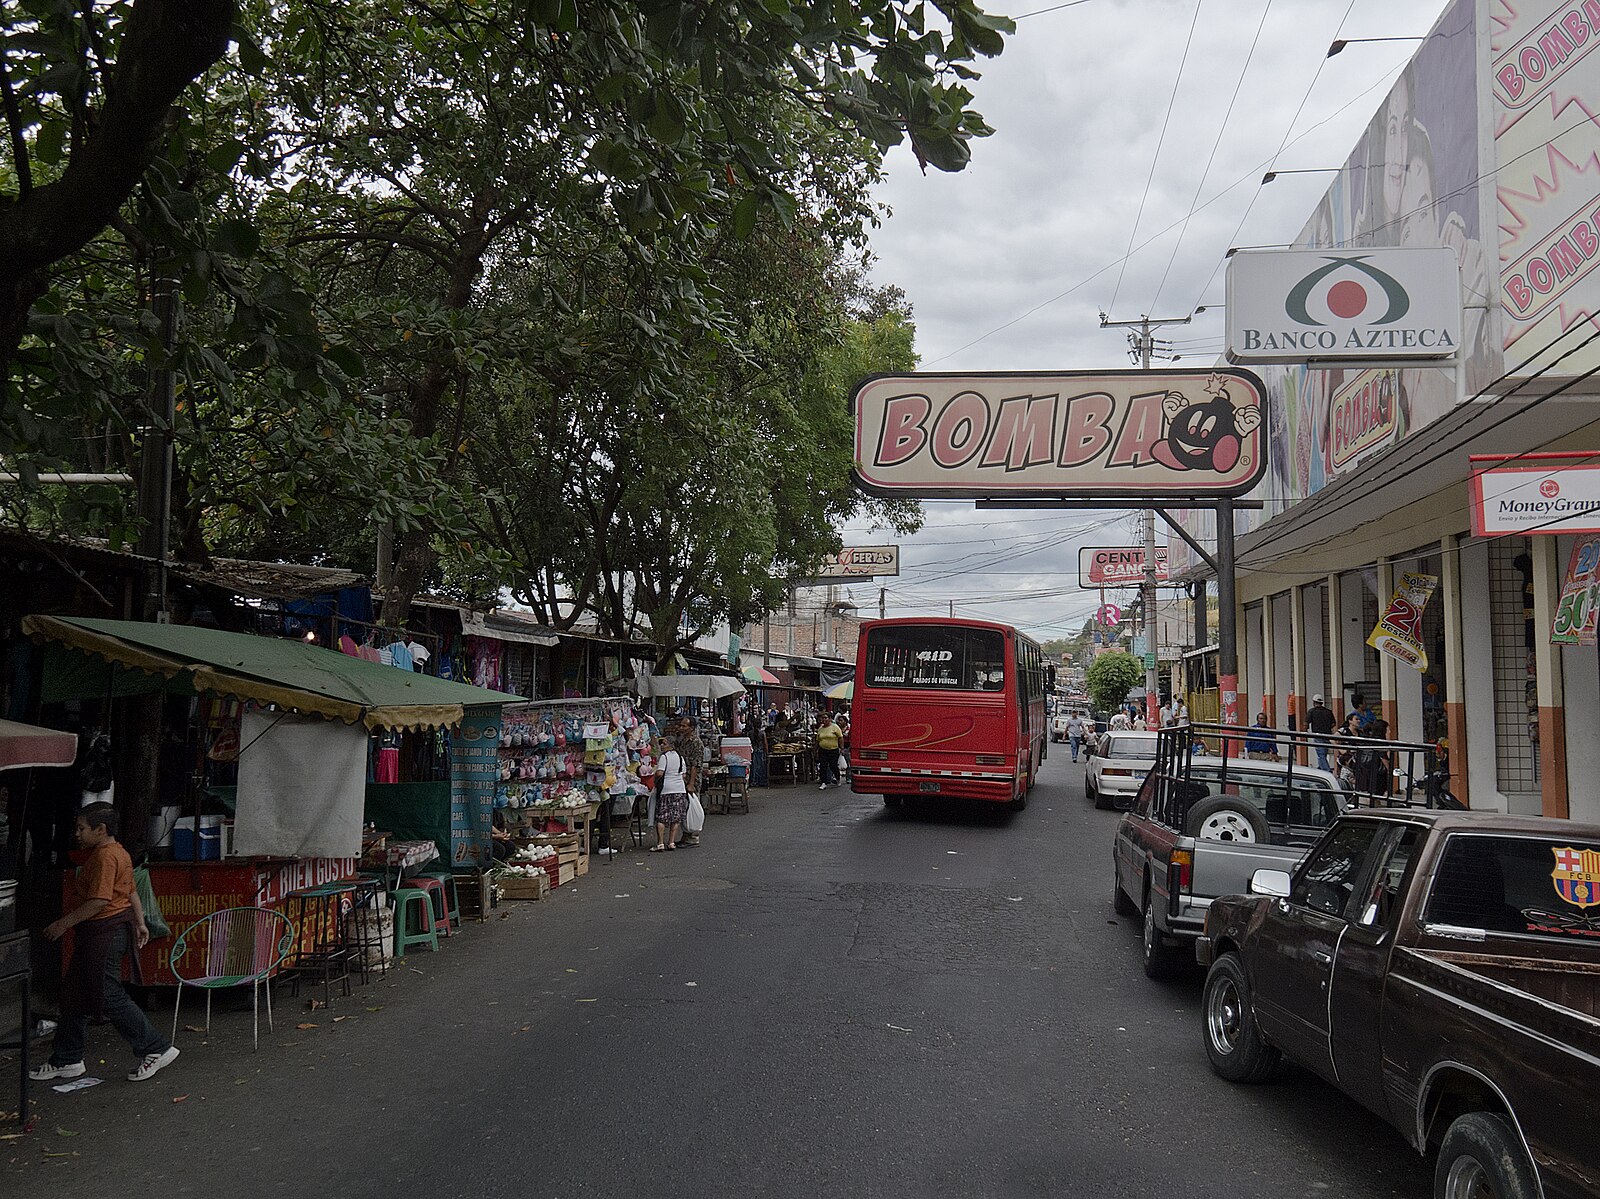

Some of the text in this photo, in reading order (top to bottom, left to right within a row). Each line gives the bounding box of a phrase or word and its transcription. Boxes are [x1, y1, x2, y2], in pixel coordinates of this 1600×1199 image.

[1243, 327, 1454, 350] BANCO AZTECA
[874, 390, 1169, 472] BOMBA
[257, 856, 354, 907] EL BUEN GUSTO
